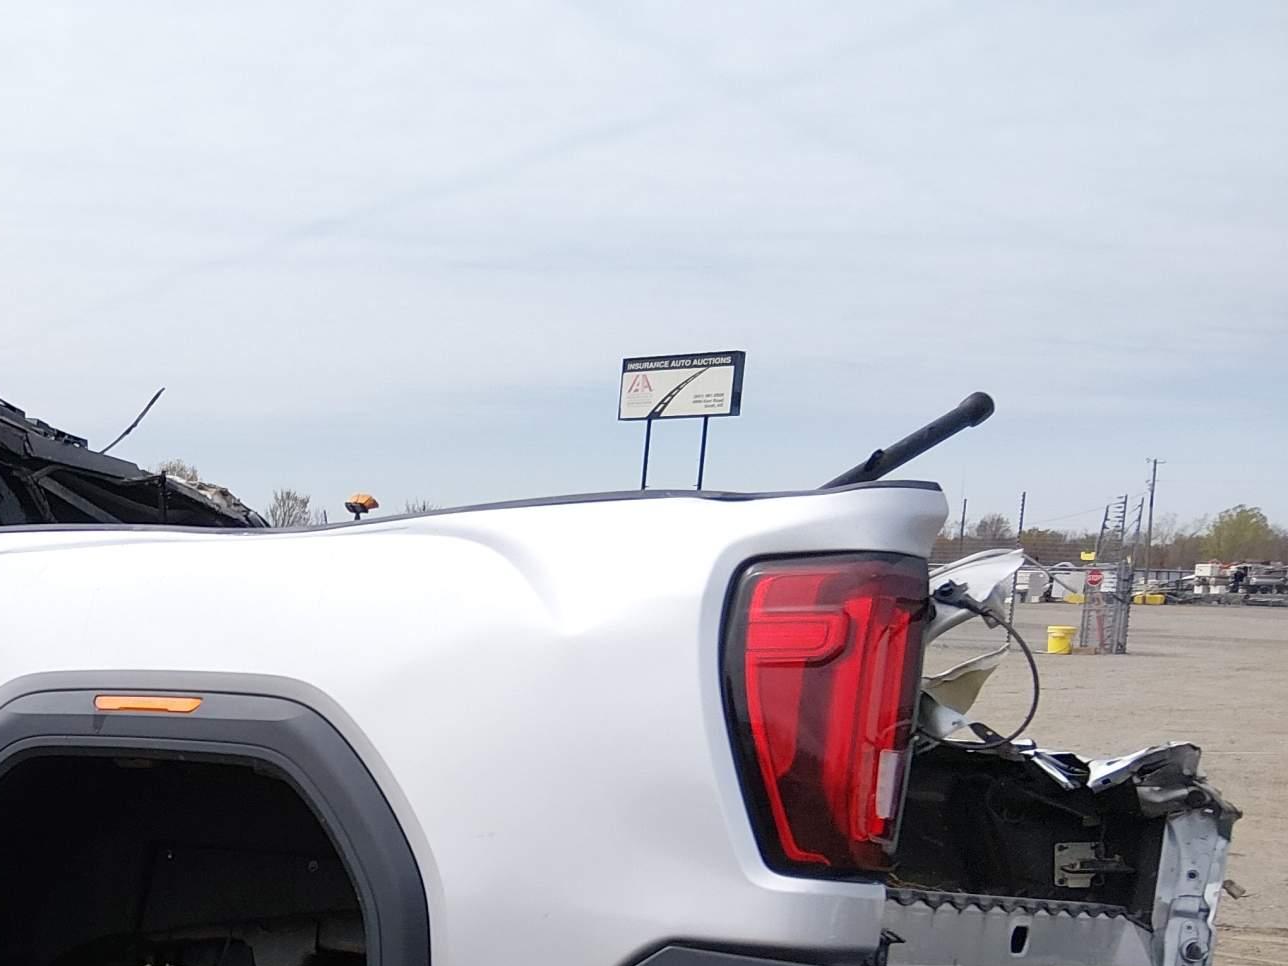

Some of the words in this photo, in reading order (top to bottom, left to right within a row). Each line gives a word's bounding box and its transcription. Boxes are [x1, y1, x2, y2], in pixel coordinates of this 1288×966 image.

[627, 361, 669, 370] INSURANCE
[670, 359, 691, 367] AUTO
[692, 356, 731, 366] AUCTIONS
